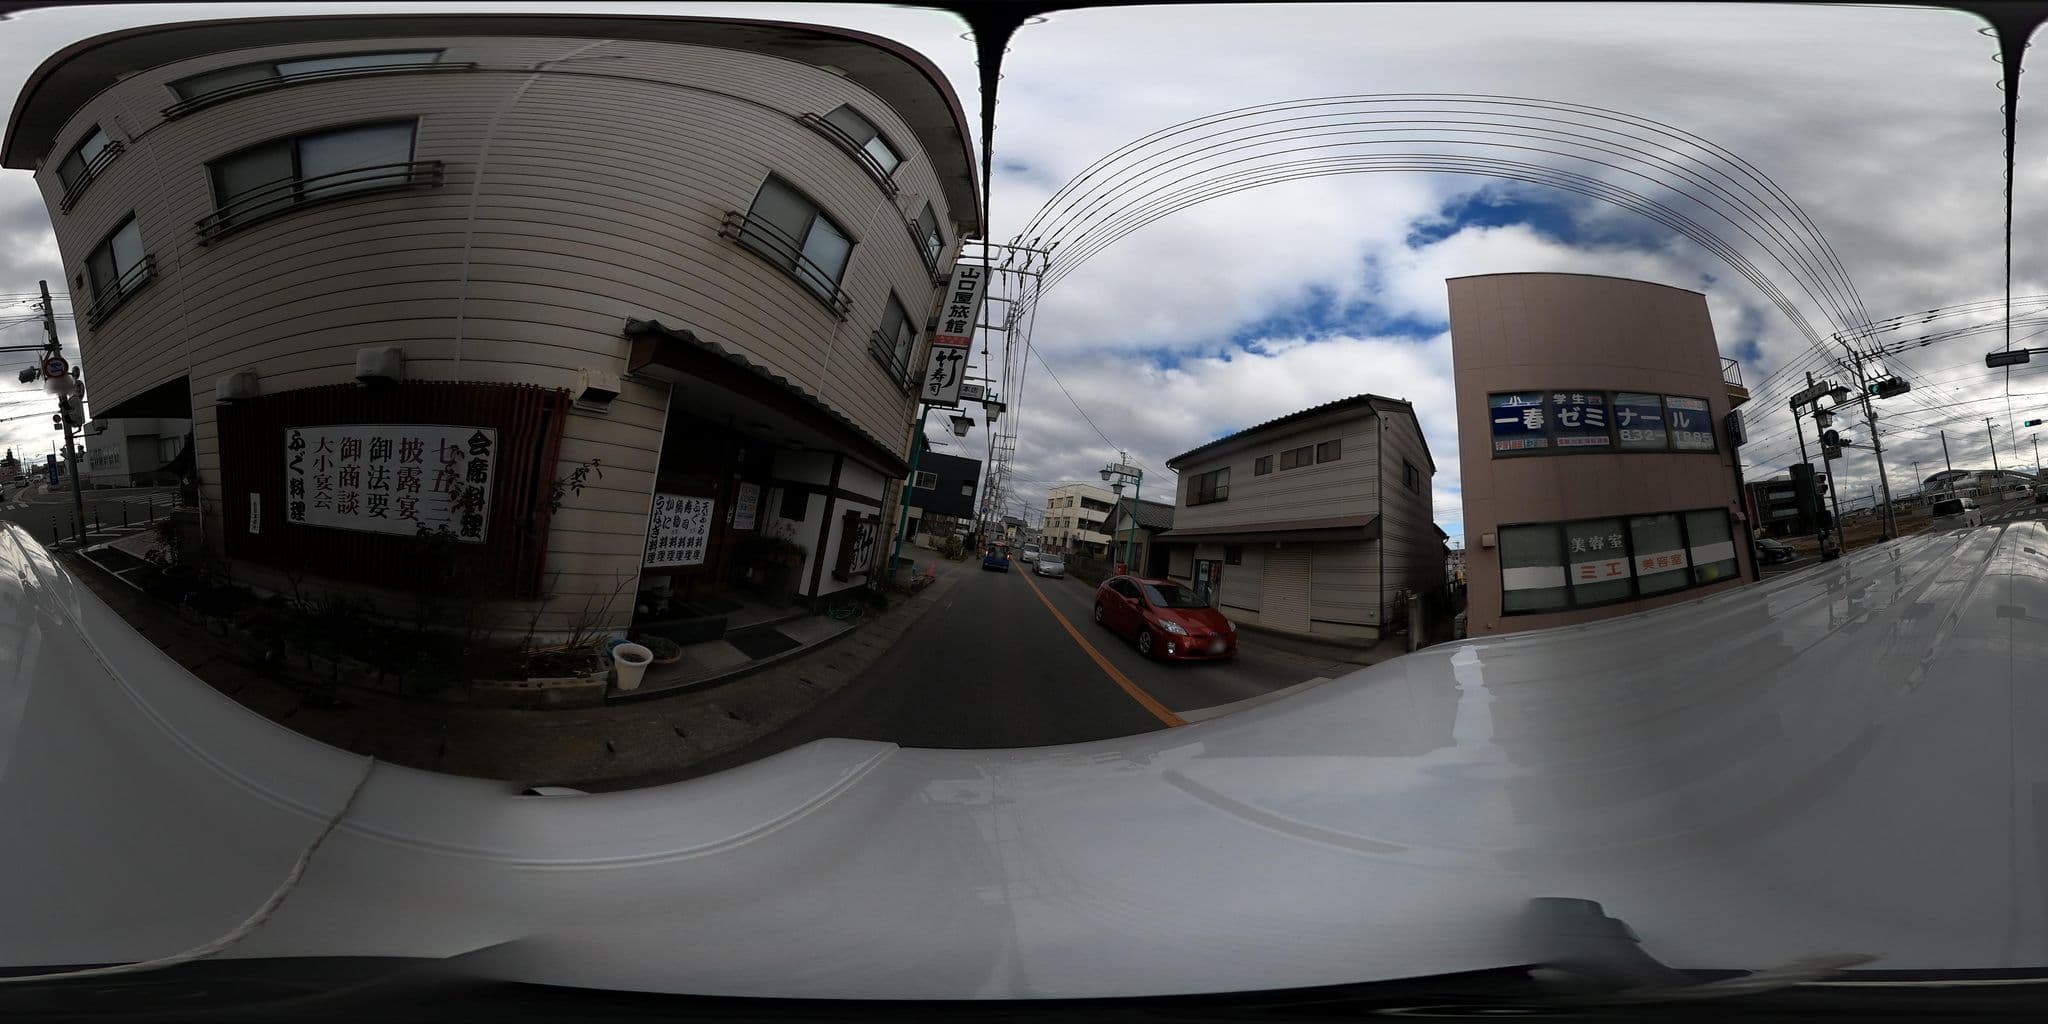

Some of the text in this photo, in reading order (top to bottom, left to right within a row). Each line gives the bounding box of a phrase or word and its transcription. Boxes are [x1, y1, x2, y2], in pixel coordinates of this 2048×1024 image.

[945, 268, 980, 333] 山口屋旅館
[288, 430, 306, 522] ふぐ料理
[312, 436, 333, 510] 大小宴会
[337, 436, 362, 516] 御商談
[367, 436, 393, 519] 御法要
[396, 437, 425, 522] 披露宴
[427, 437, 455, 522] 七五三
[460, 430, 493, 540] 会席料理
[675, 500, 693, 561] 寿司料理
[1571, 534, 1623, 552] 美容室
[1642, 554, 1682, 571] 美容室
